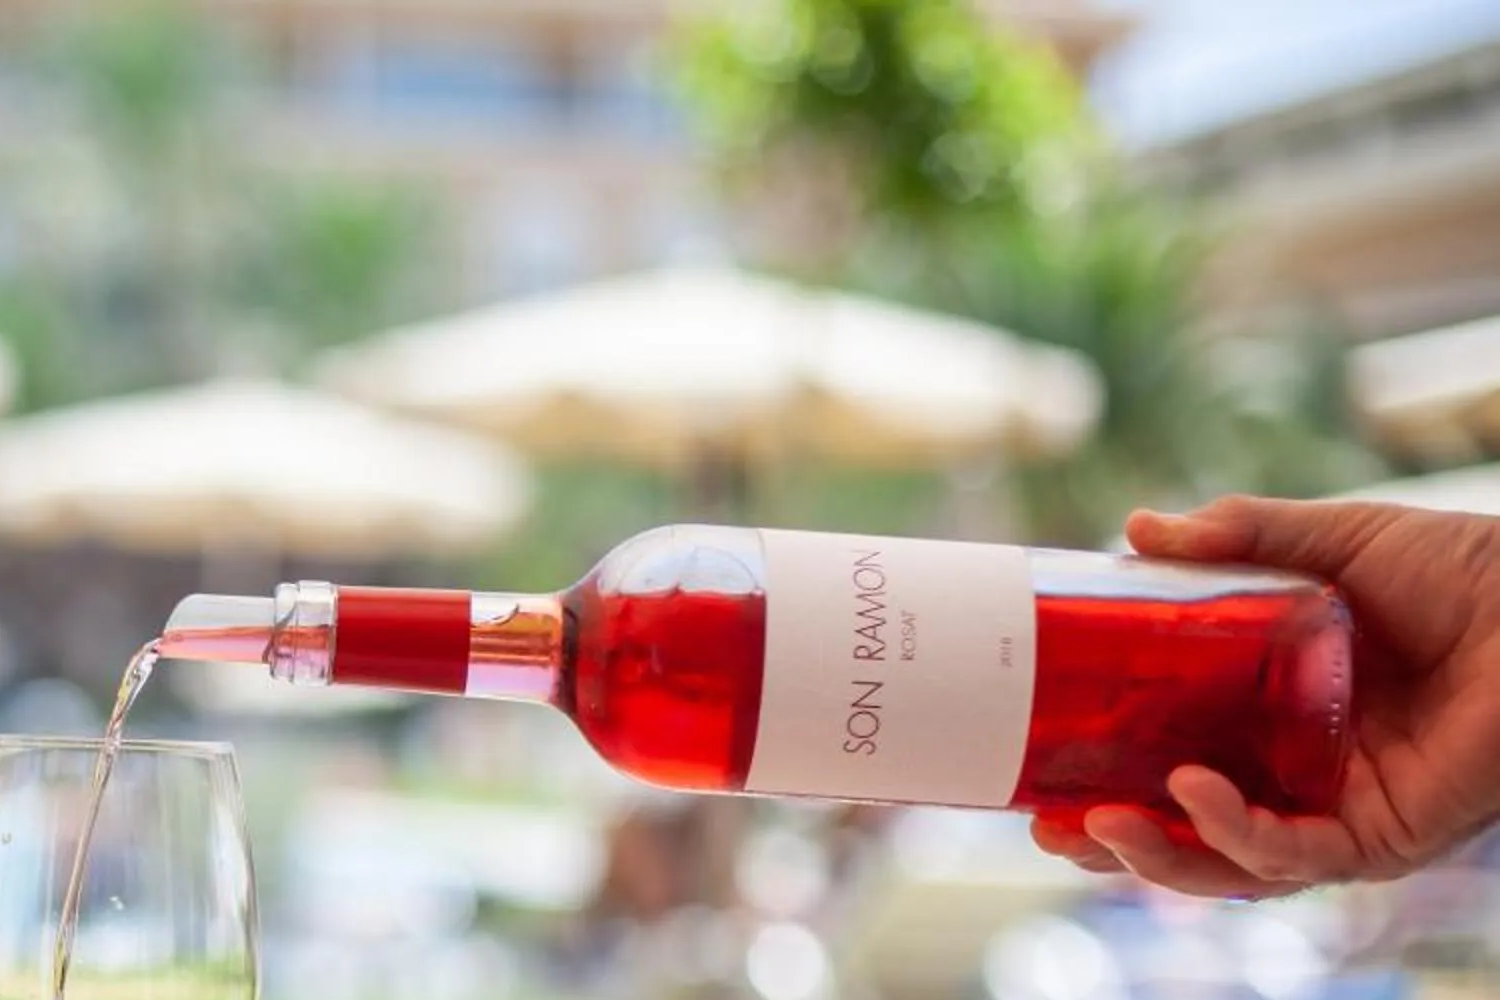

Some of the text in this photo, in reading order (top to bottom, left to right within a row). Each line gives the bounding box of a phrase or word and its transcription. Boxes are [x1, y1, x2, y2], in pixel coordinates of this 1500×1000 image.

[843, 549, 887, 755] SON RAMON
[900, 609, 917, 661] ROSAT
